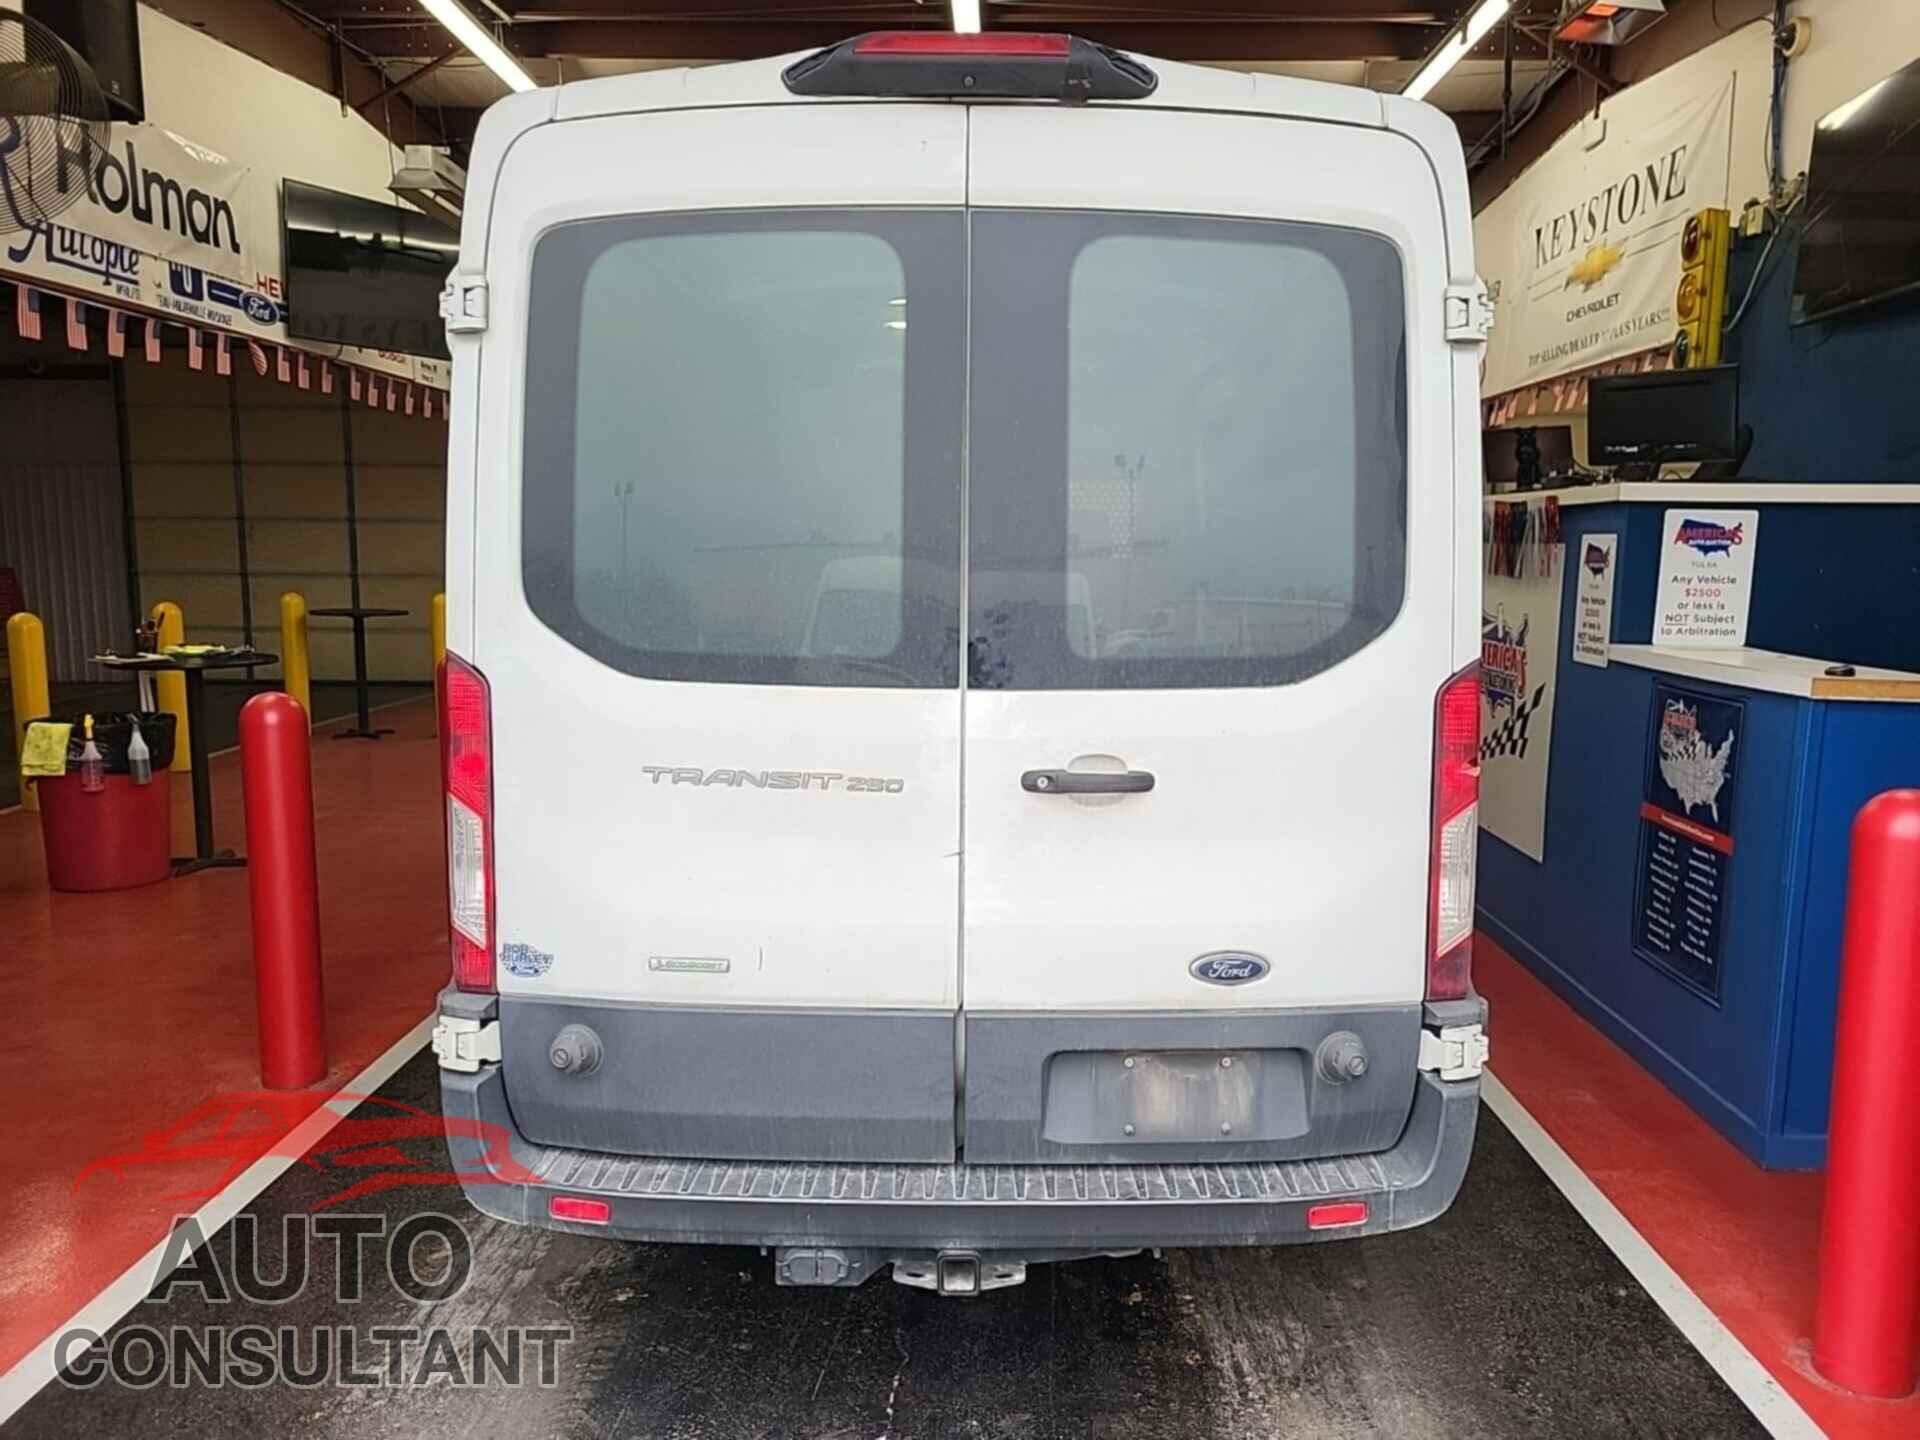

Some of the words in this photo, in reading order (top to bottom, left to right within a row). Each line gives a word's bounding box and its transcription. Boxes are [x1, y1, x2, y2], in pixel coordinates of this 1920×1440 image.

[1535, 144, 1688, 269] KEYSTONE
[1671, 575, 1693, 585] Any
[1697, 575, 1737, 585] Vehicle
[1685, 588, 1721, 598] $2500
[1677, 602, 1688, 610] or
[1693, 601, 1713, 610] less
[1717, 601, 1725, 610] is
[1665, 613, 1689, 624] NOT
[1693, 613, 1735, 625] Subject
[1660, 627, 1672, 636] to
[1676, 627, 1737, 637] Arbitration
[641, 765, 843, 791] TRANSIT
[1207, 959, 1253, 978] Ford
